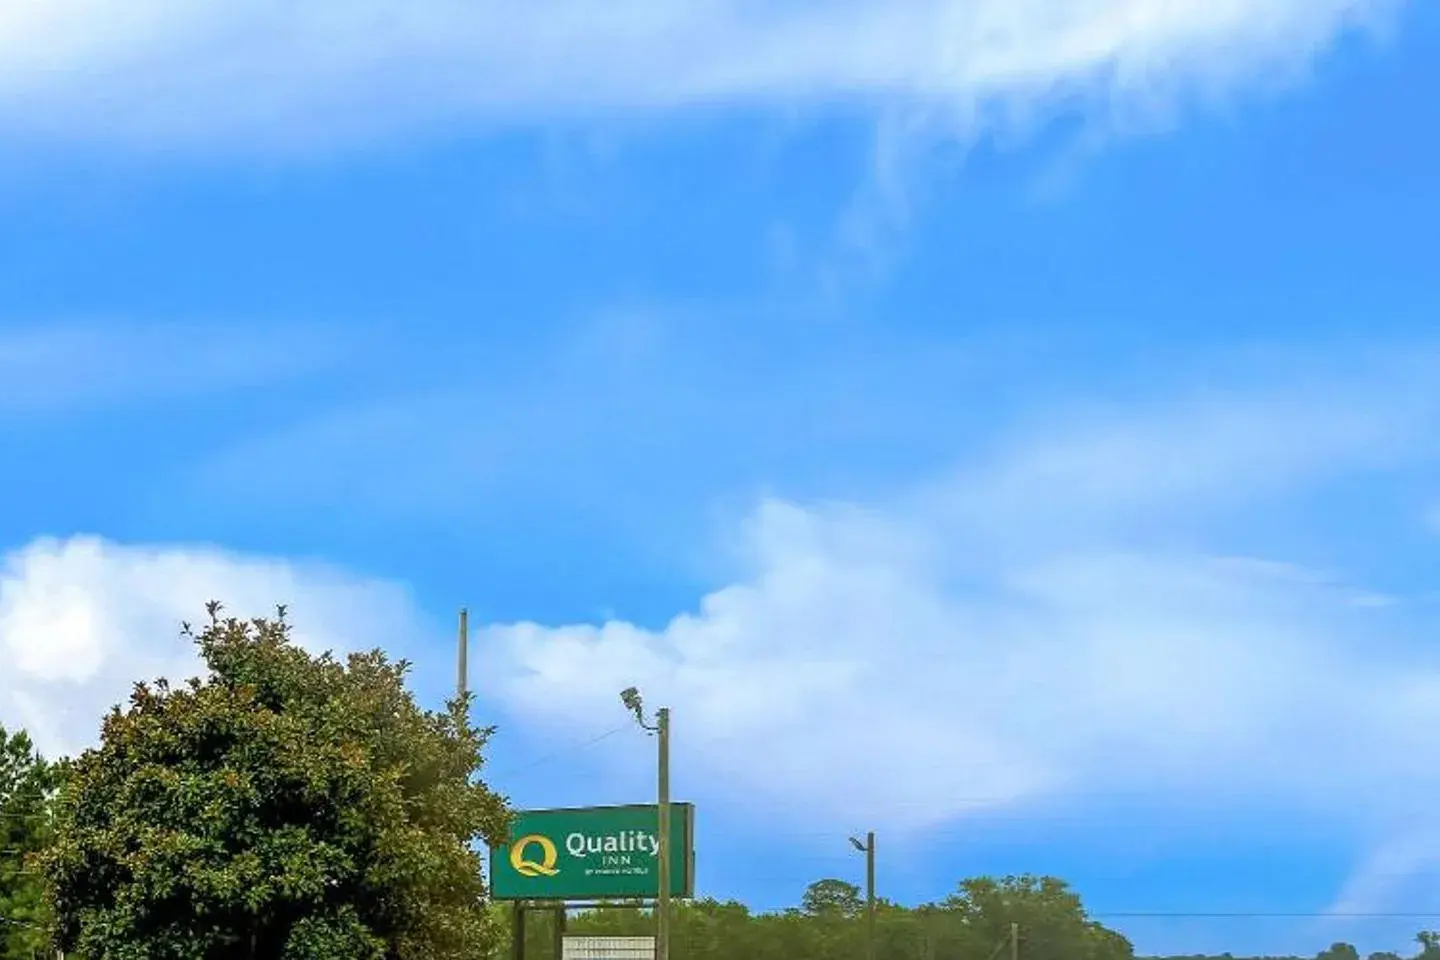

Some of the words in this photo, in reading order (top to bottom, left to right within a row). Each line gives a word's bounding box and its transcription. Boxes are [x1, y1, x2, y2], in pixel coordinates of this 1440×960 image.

[510, 834, 560, 876] Q
[566, 830, 660, 857] Quality
[602, 855, 631, 867] INN
